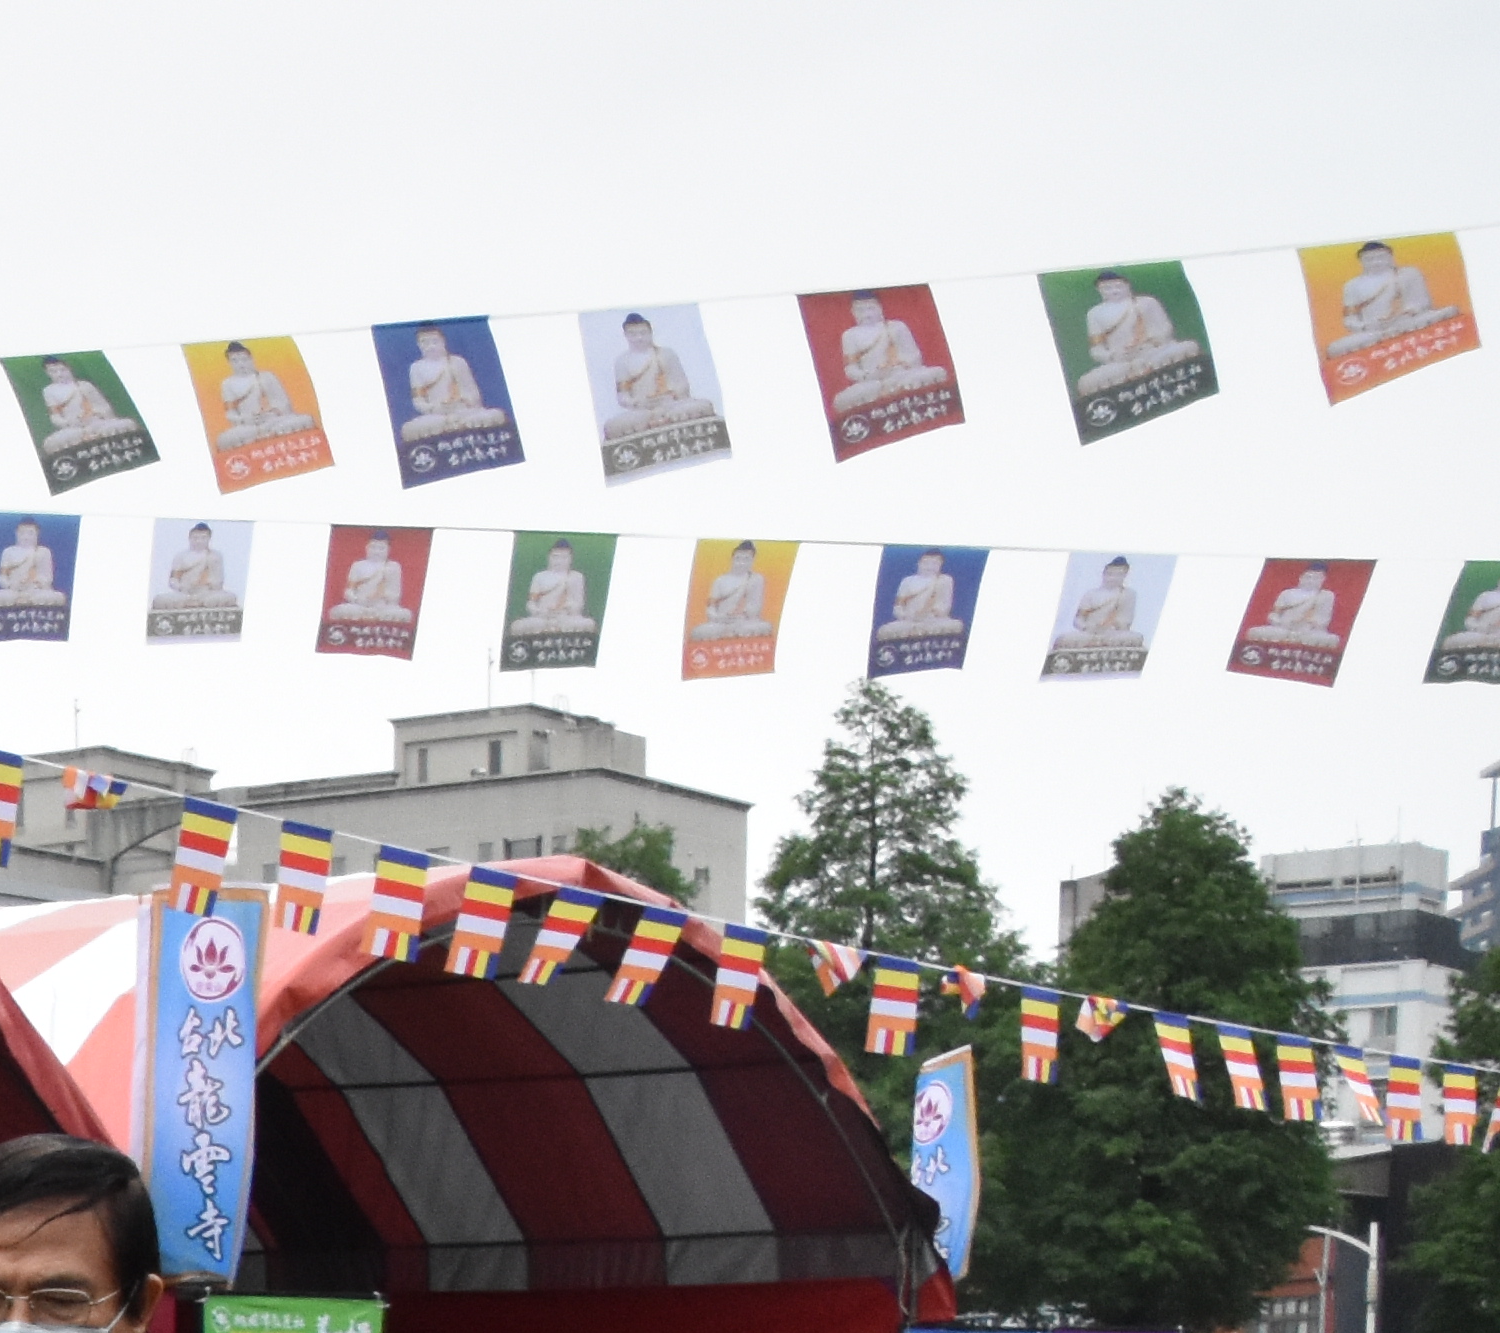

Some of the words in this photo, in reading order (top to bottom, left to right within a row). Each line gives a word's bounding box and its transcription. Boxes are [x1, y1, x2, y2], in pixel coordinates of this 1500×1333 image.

[177, 1005, 245, 1263] 台北龍雲寺
